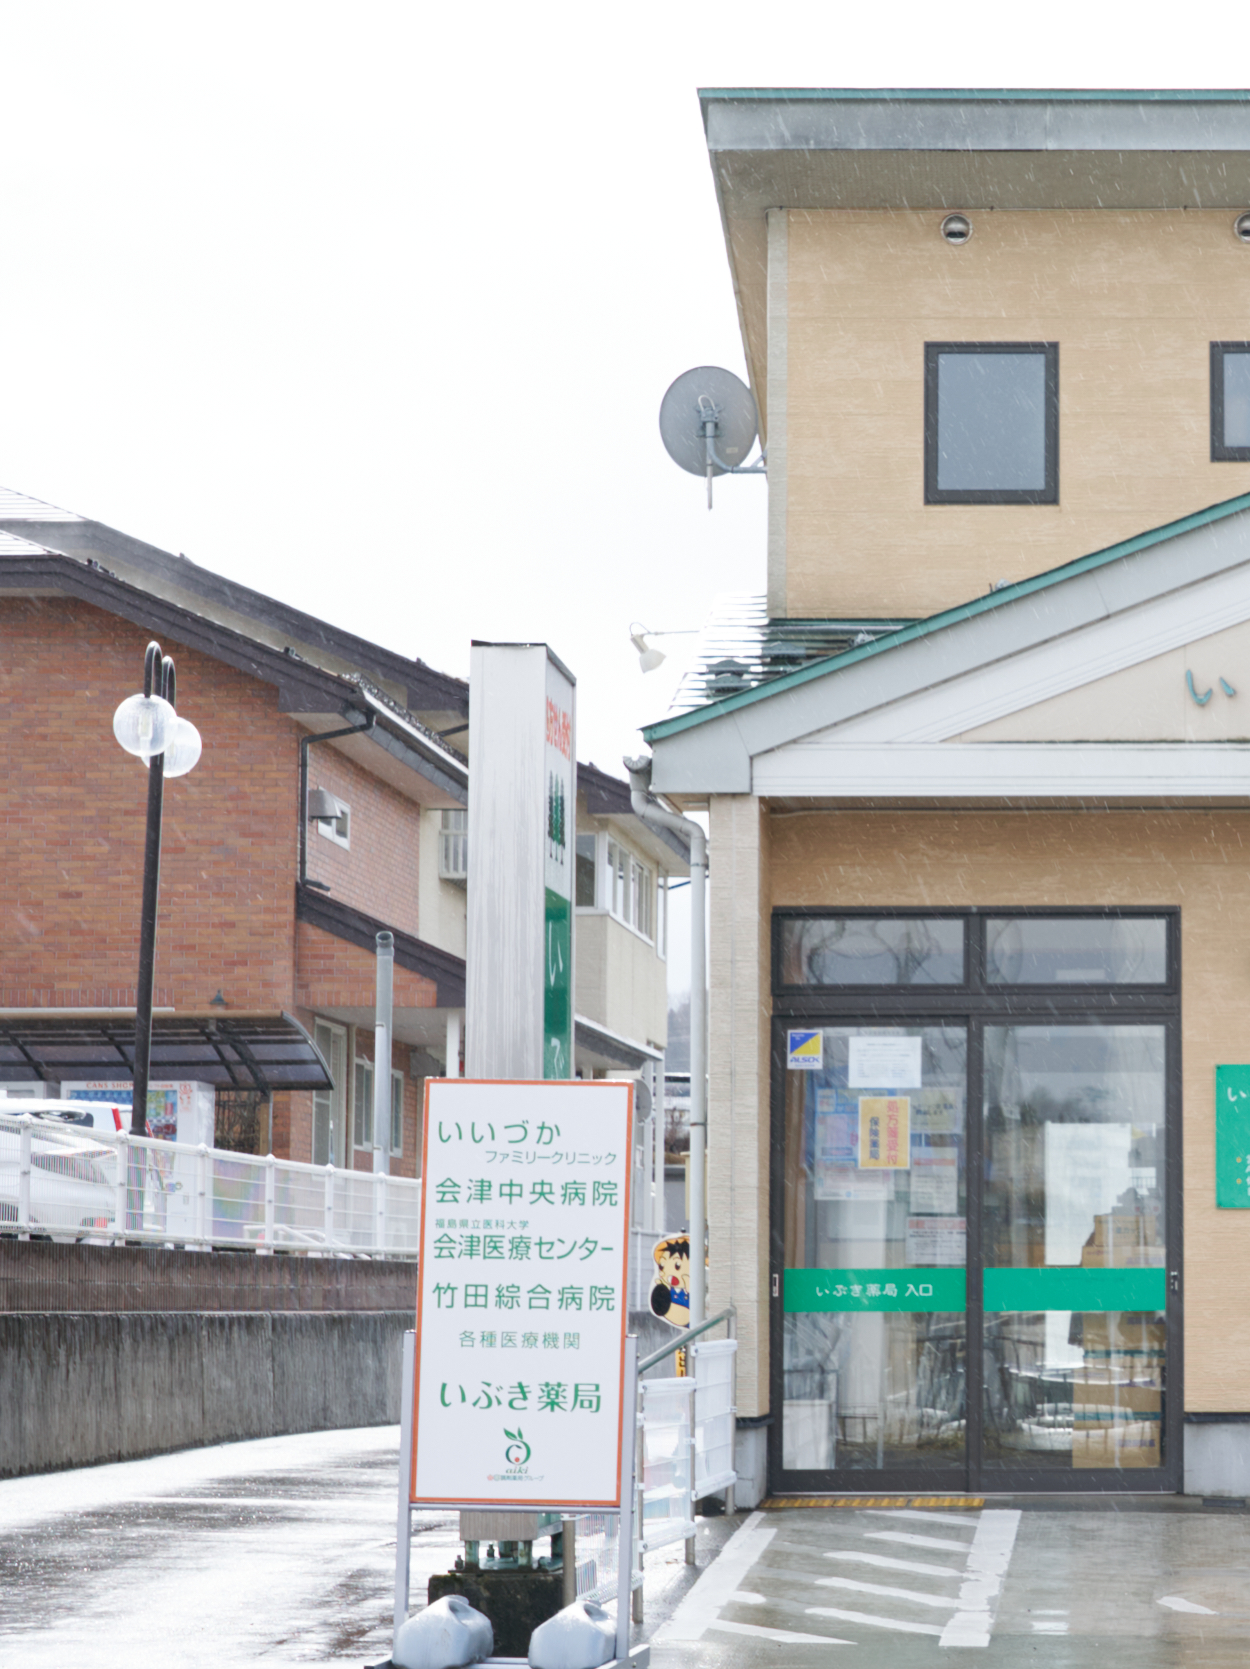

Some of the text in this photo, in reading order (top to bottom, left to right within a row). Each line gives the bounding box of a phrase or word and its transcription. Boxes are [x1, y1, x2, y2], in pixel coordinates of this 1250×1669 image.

[437, 1119, 561, 1145] いいづか
[485, 1150, 617, 1166] ファミリークリニック
[435, 1177, 619, 1207] 会津中央病院
[435, 1218, 530, 1231] 福島県立医科大学
[433, 1233, 614, 1261] 会津医療センター
[432, 1282, 616, 1311] 竹田綜合病院
[816, 1283, 933, 1297] いぶき薬局 入口
[458, 1330, 581, 1350] 各種医療機関
[439, 1380, 602, 1414] いぶき薬局
[506, 1466, 529, 1474] aiki
